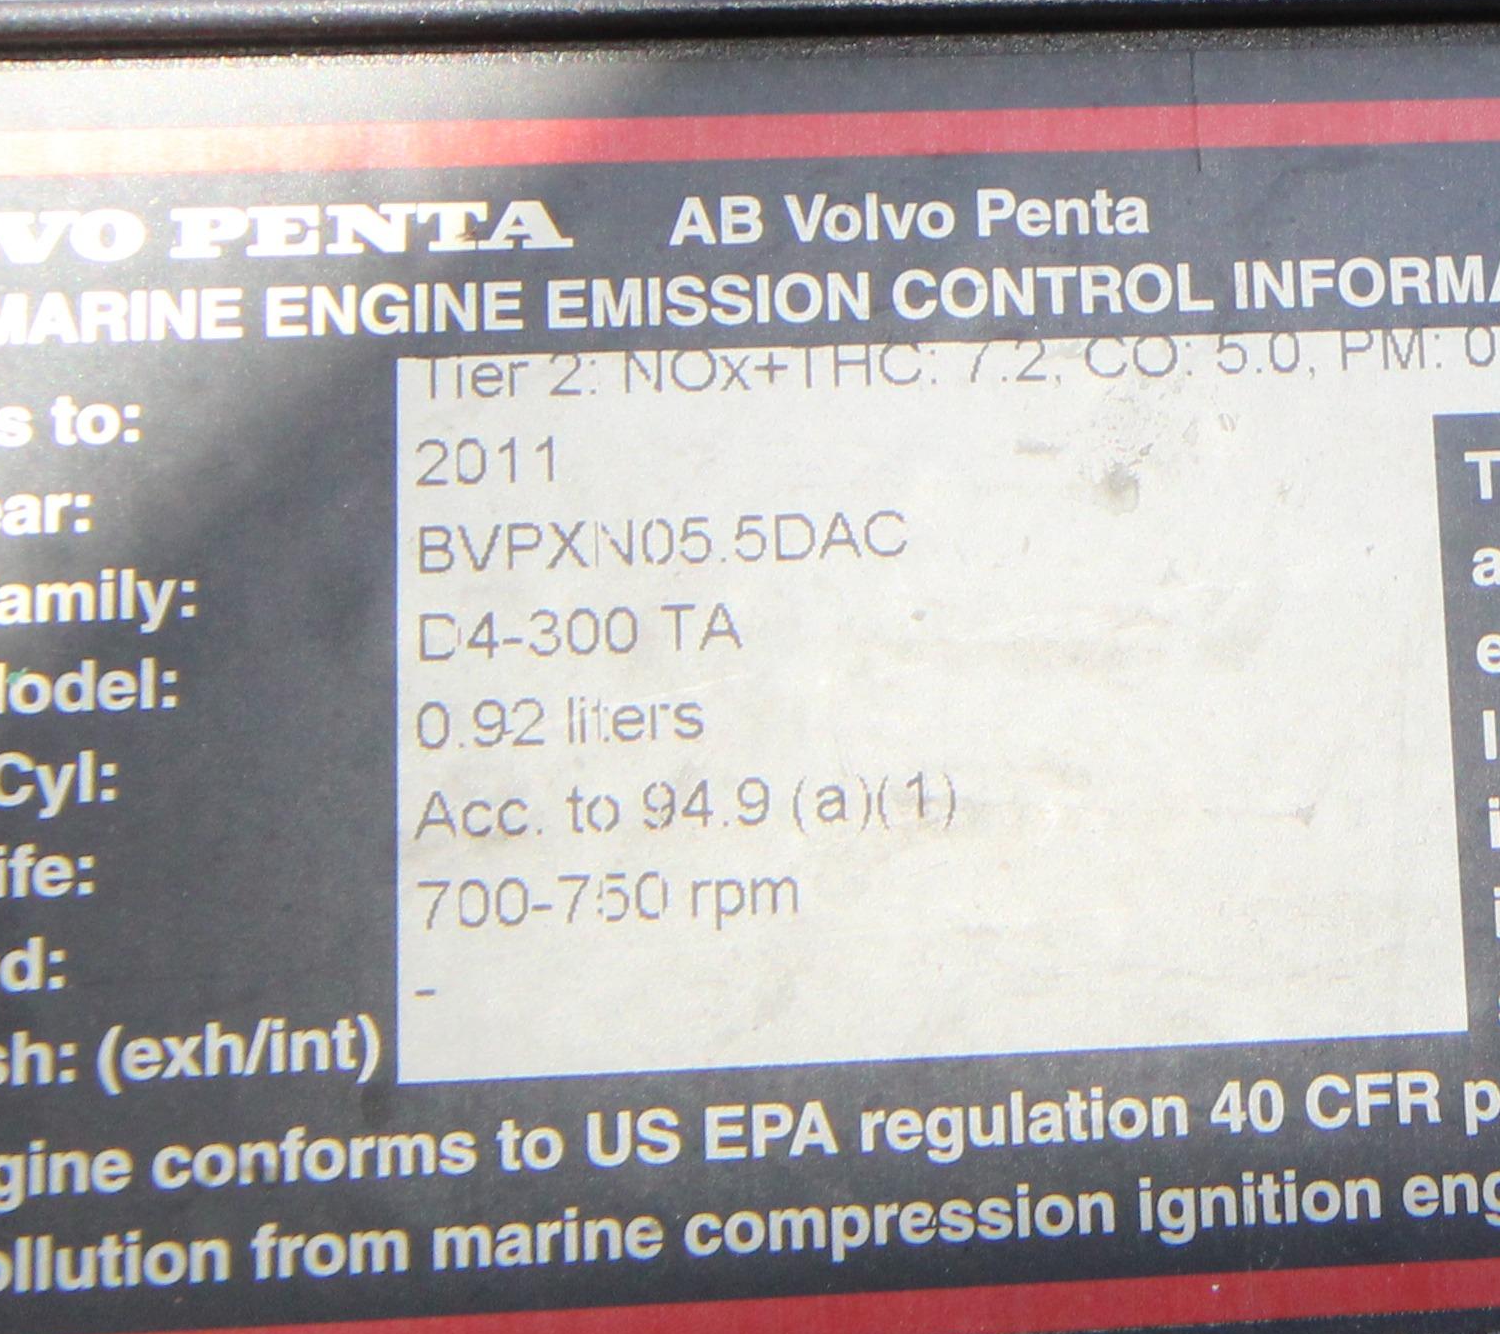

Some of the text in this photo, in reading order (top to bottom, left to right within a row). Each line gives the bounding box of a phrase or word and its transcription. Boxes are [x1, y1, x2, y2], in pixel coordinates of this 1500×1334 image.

[169, 200, 572, 260] PENTA
[670, 189, 1149, 245] AB Volvo Penta
[263, 279, 523, 335] ENGINE
[548, 272, 869, 328] EMISSION
[893, 263, 1214, 319] CONTROL
[50, 395, 140, 445] to:
[416, 436, 553, 486] 2011
[419, 511, 907, 574] BVPXN05.5DAC
[420, 603, 742, 661] D4-300 TA
[417, 695, 705, 750] 0.92 liters
[413, 771, 958, 840] Acc. to 94.9 (a)(1)
[415, 870, 801, 930] 700-750 rpm
[98, 1014, 380, 1094] (exh/int)
[153, 1127, 477, 1188] conforms
[497, 1120, 563, 1170] to
[588, 1108, 680, 1166] US
[705, 1101, 838, 1159] EPA
[861, 1086, 1188, 1162] regulation
[1211, 1080, 1284, 1132] 40
[1306, 1071, 1440, 1128] CFR
[251, 1223, 408, 1279] from
[434, 1207, 663, 1269] marine
[685, 1183, 1114, 1261] compression
[1139, 1170, 1381, 1244] ignition
